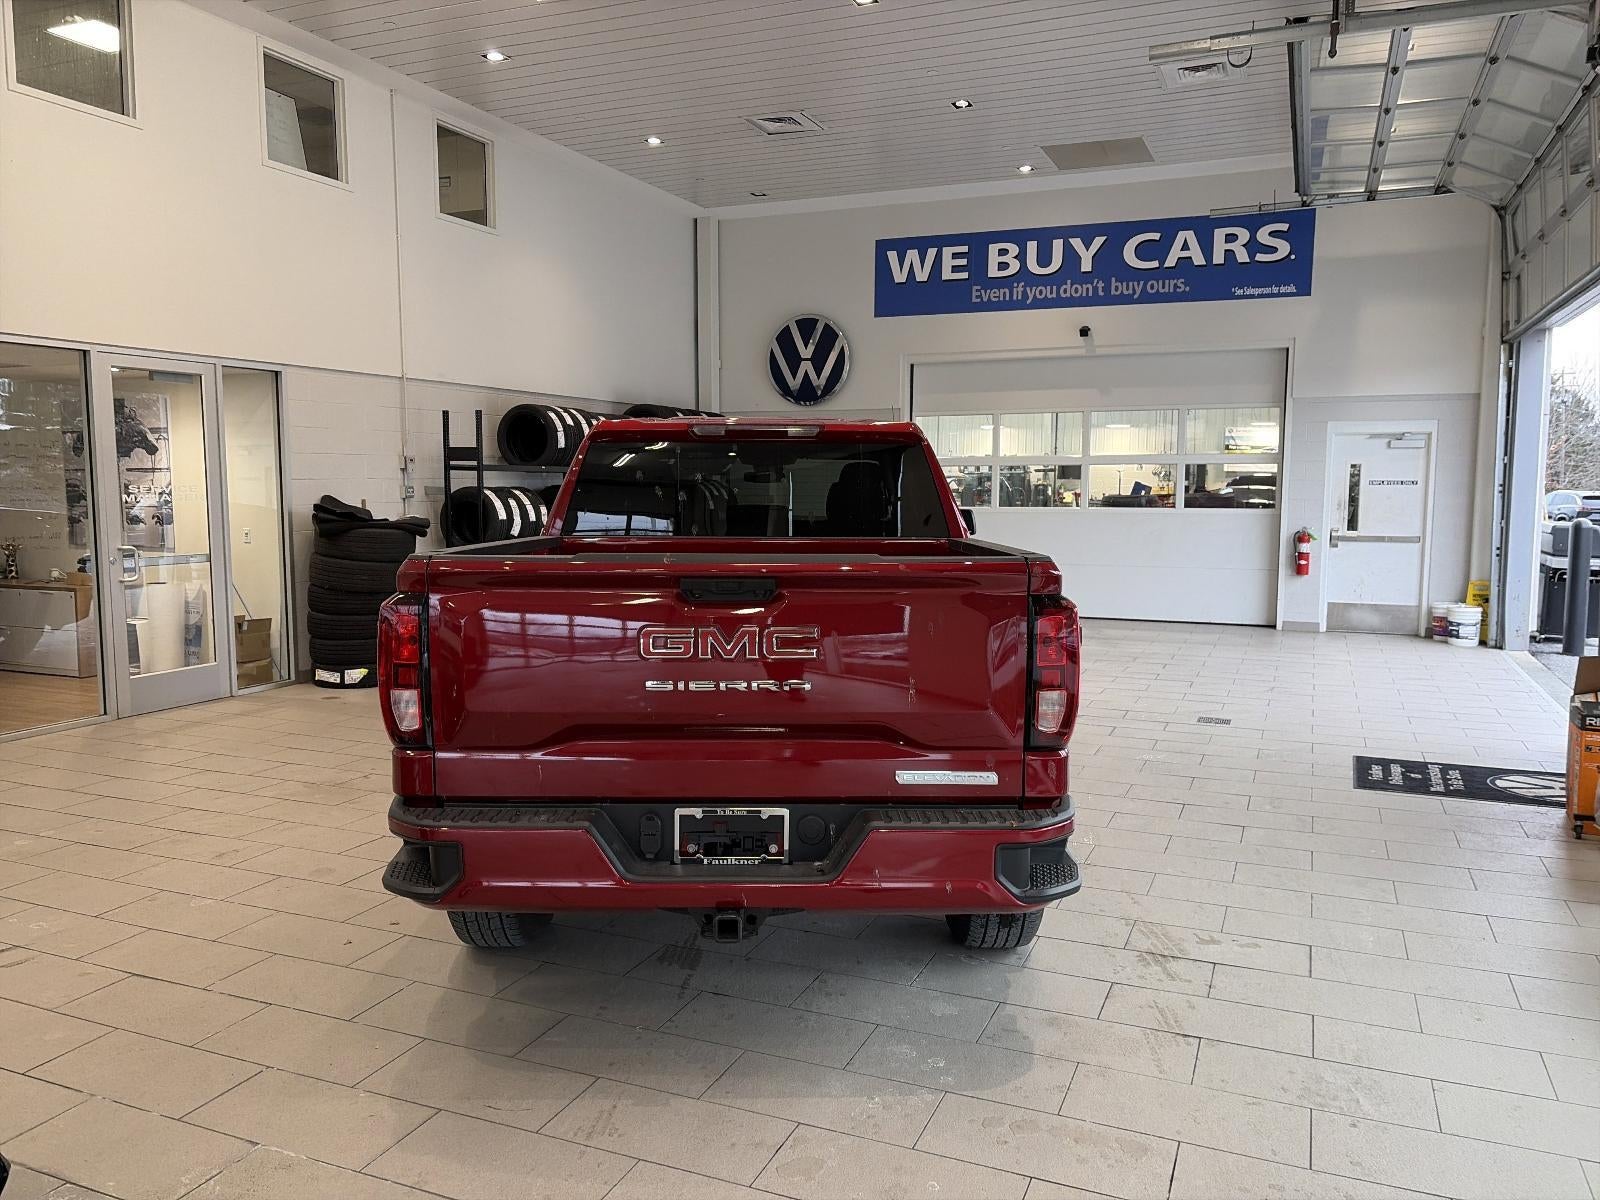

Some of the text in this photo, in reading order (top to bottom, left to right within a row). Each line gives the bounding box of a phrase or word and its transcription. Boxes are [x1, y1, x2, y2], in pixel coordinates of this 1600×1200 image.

[886, 222, 1296, 284] WE BUY CARS.
[971, 277, 1190, 304] Even if you don't buy ours.
[1244, 286, 1271, 297] Salesperson
[128, 484, 198, 493] SERVCE
[640, 625, 820, 659] GMC
[645, 680, 812, 691] SIERRA
